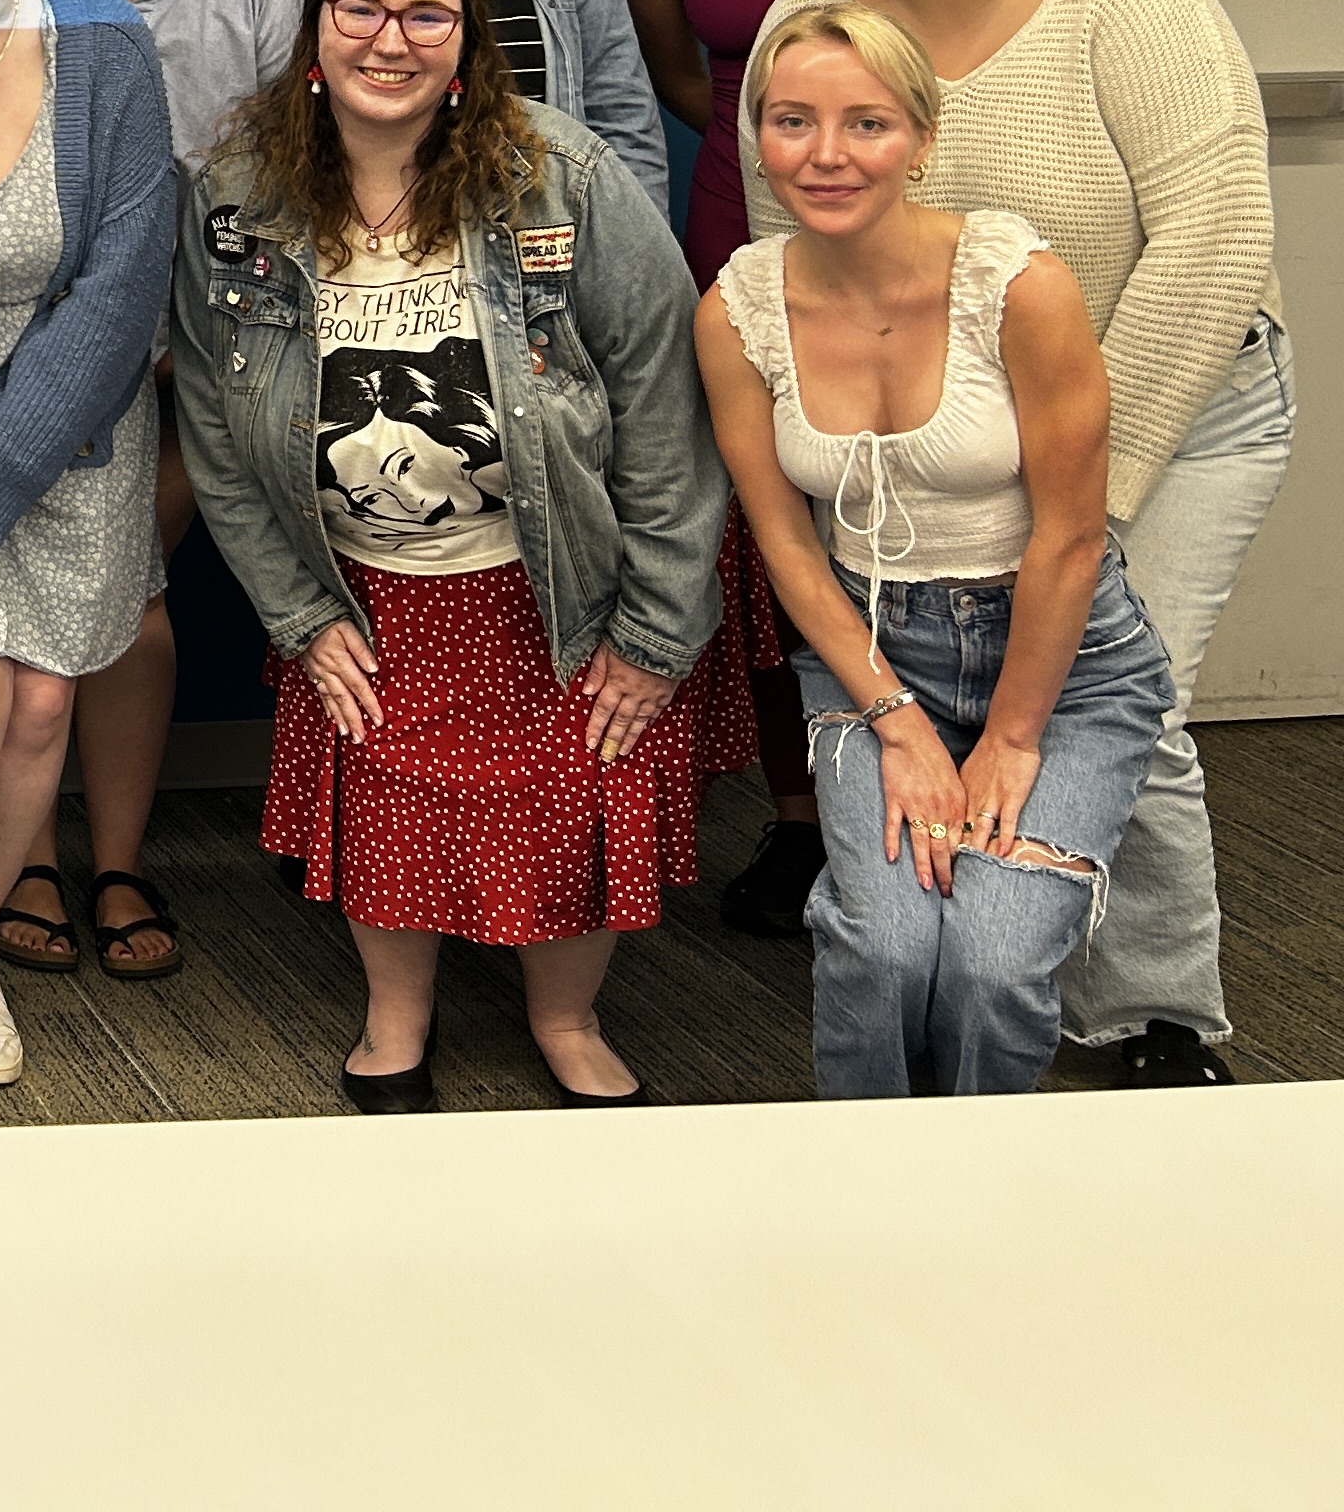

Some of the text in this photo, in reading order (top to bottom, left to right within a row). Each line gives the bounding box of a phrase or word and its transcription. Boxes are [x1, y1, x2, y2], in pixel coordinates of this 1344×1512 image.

[521, 244, 557, 258] SPREAD
[317, 288, 349, 315] SY
[318, 303, 462, 343] BOUT GIRLS
